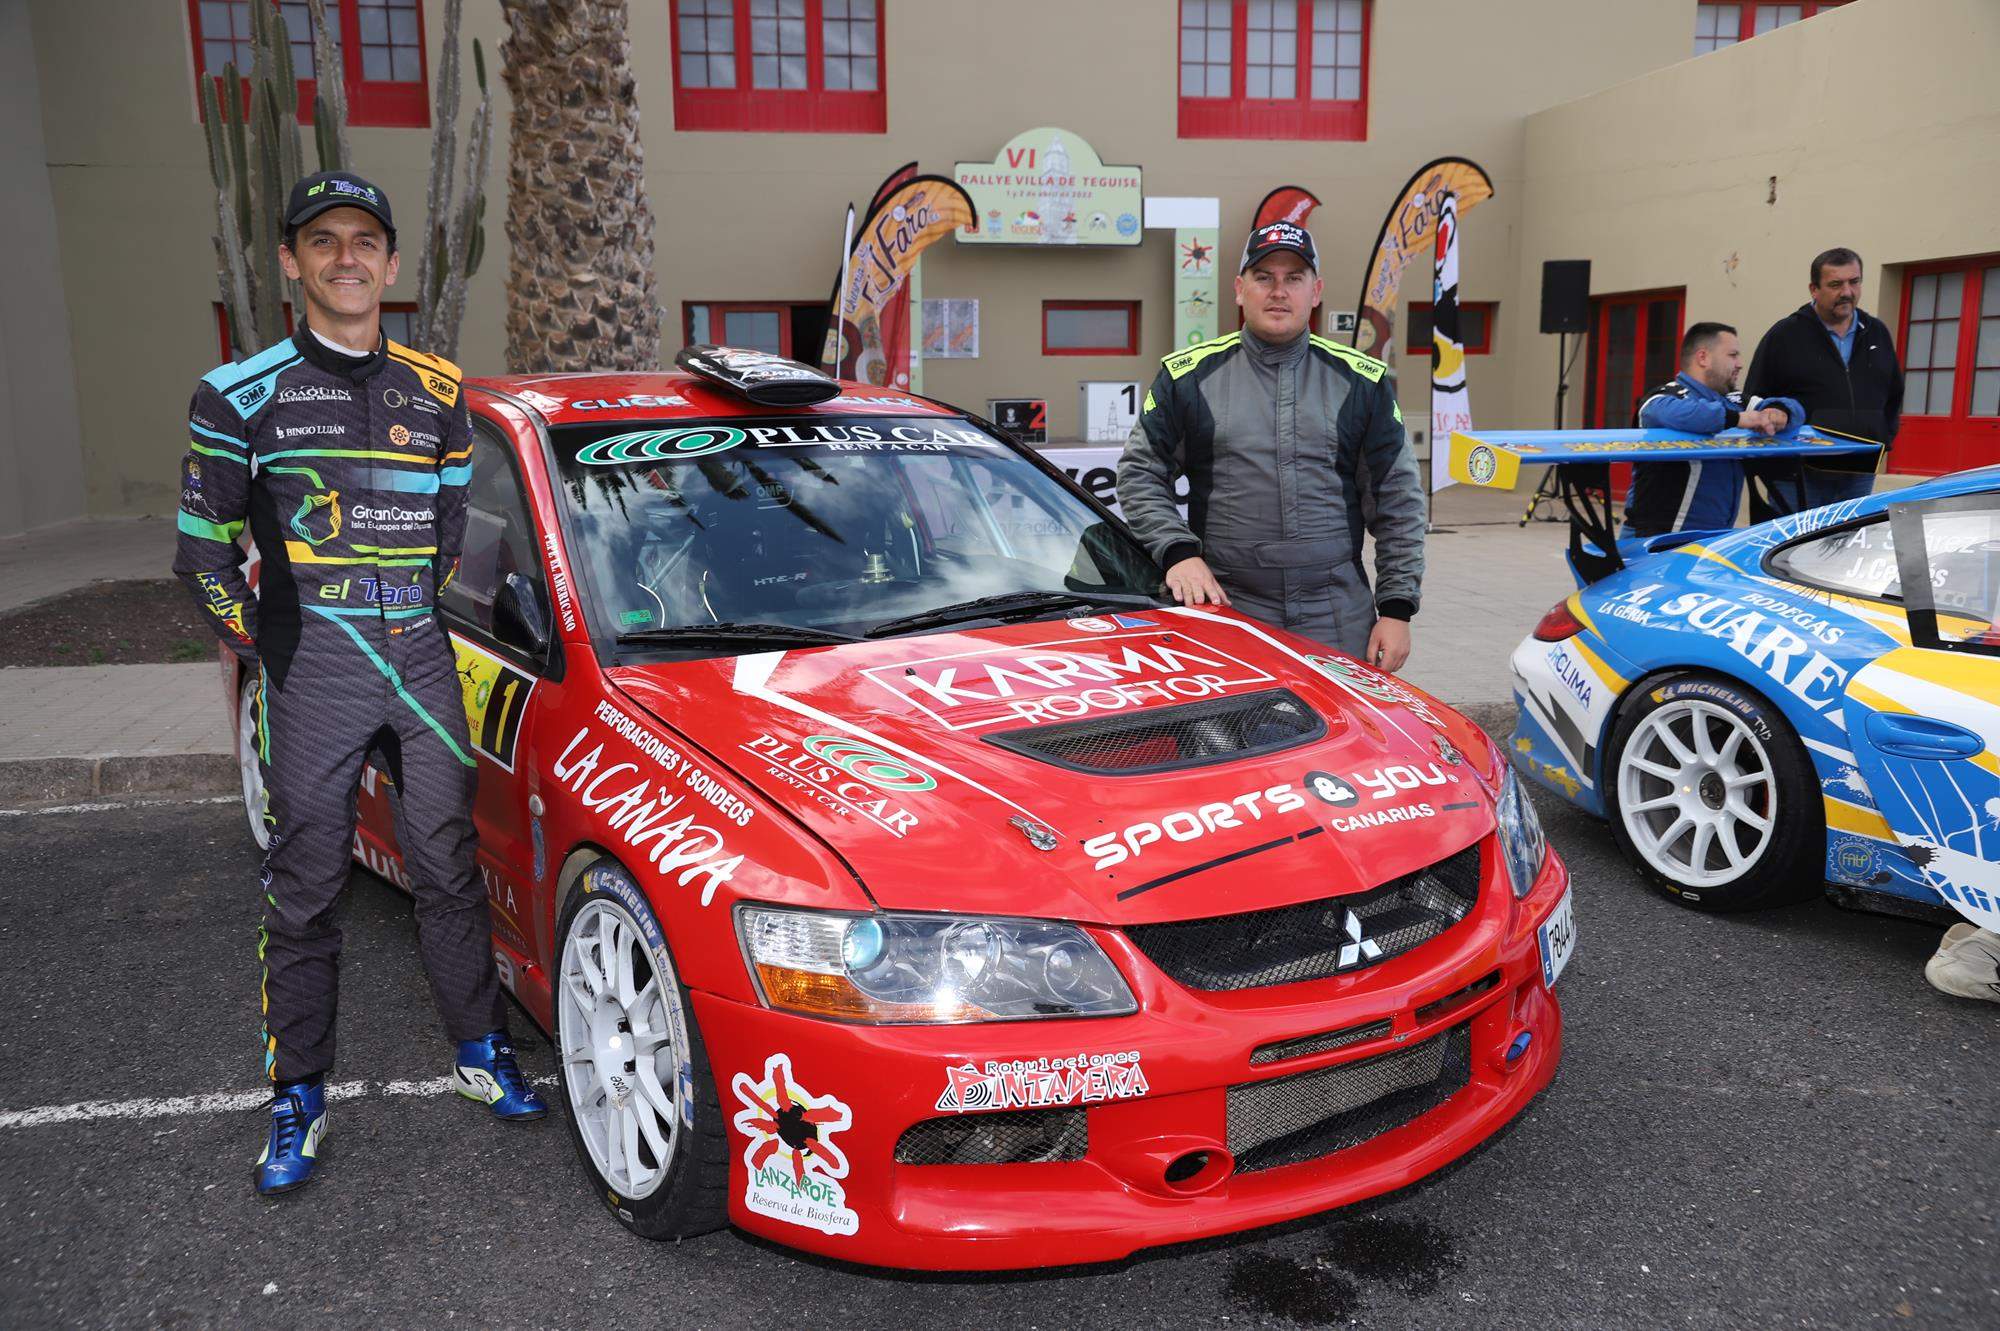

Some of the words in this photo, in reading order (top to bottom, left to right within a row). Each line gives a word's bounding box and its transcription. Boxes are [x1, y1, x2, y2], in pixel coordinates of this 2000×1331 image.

[1006, 148, 1035, 169] VI
[307, 180, 326, 197] el
[960, 175, 1011, 185] RALLYE
[1015, 176, 1055, 186] VILLA
[1059, 176, 1075, 186] DE
[1083, 176, 1138, 188] TEGUISE
[1171, 356, 1194, 369] OMP
[1356, 360, 1379, 374] OMP
[238, 384, 267, 406] OMP
[429, 378, 454, 396] OMP
[1120, 384, 1136, 416] 1
[571, 394, 691, 411] CLICK
[1028, 402, 1046, 430] 2
[286, 426, 316, 437] BINGO
[745, 425, 882, 444] PLUS
[891, 426, 994, 446] CAR
[828, 443, 884, 451] RENT
[905, 443, 950, 451] CAR
[756, 485, 784, 498] OMP
[544, 533, 561, 558] PEPE
[319, 579, 351, 600] el
[359, 577, 422, 605] Taro
[552, 571, 576, 632] AMERICANO
[1597, 601, 1613, 616] LA
[1739, 592, 1846, 645] BODEGAS
[904, 642, 1228, 707] KARMA
[1012, 673, 1240, 724] ROOFTOP
[1677, 684, 1754, 715] MICHELIN
[495, 680, 520, 754] 1
[594, 700, 678, 770] PERFORACIONES
[676, 756, 692, 778] Y
[685, 768, 755, 828] SONDEOS
[745, 733, 840, 783] PLUS
[837, 782, 919, 835] CAR
[766, 767, 807, 790] RENT
[817, 795, 850, 816] CAR
[553, 727, 604, 794] LA
[582, 762, 746, 907] CAÑADA
[1083, 783, 1305, 872] SPORTS
[1313, 777, 1356, 803] &
[1331, 802, 1436, 833] CANARIAS
[600, 872, 657, 939] MICHELIN
[986, 1051, 1141, 1076] Rotulaciones
[947, 1063, 1151, 1111] PINTADERA
[753, 1166, 838, 1208] LANZAROTE
[751, 1191, 790, 1216] Reserva
[790, 1203, 805, 1218] de
[806, 1206, 851, 1228] Biosfera
